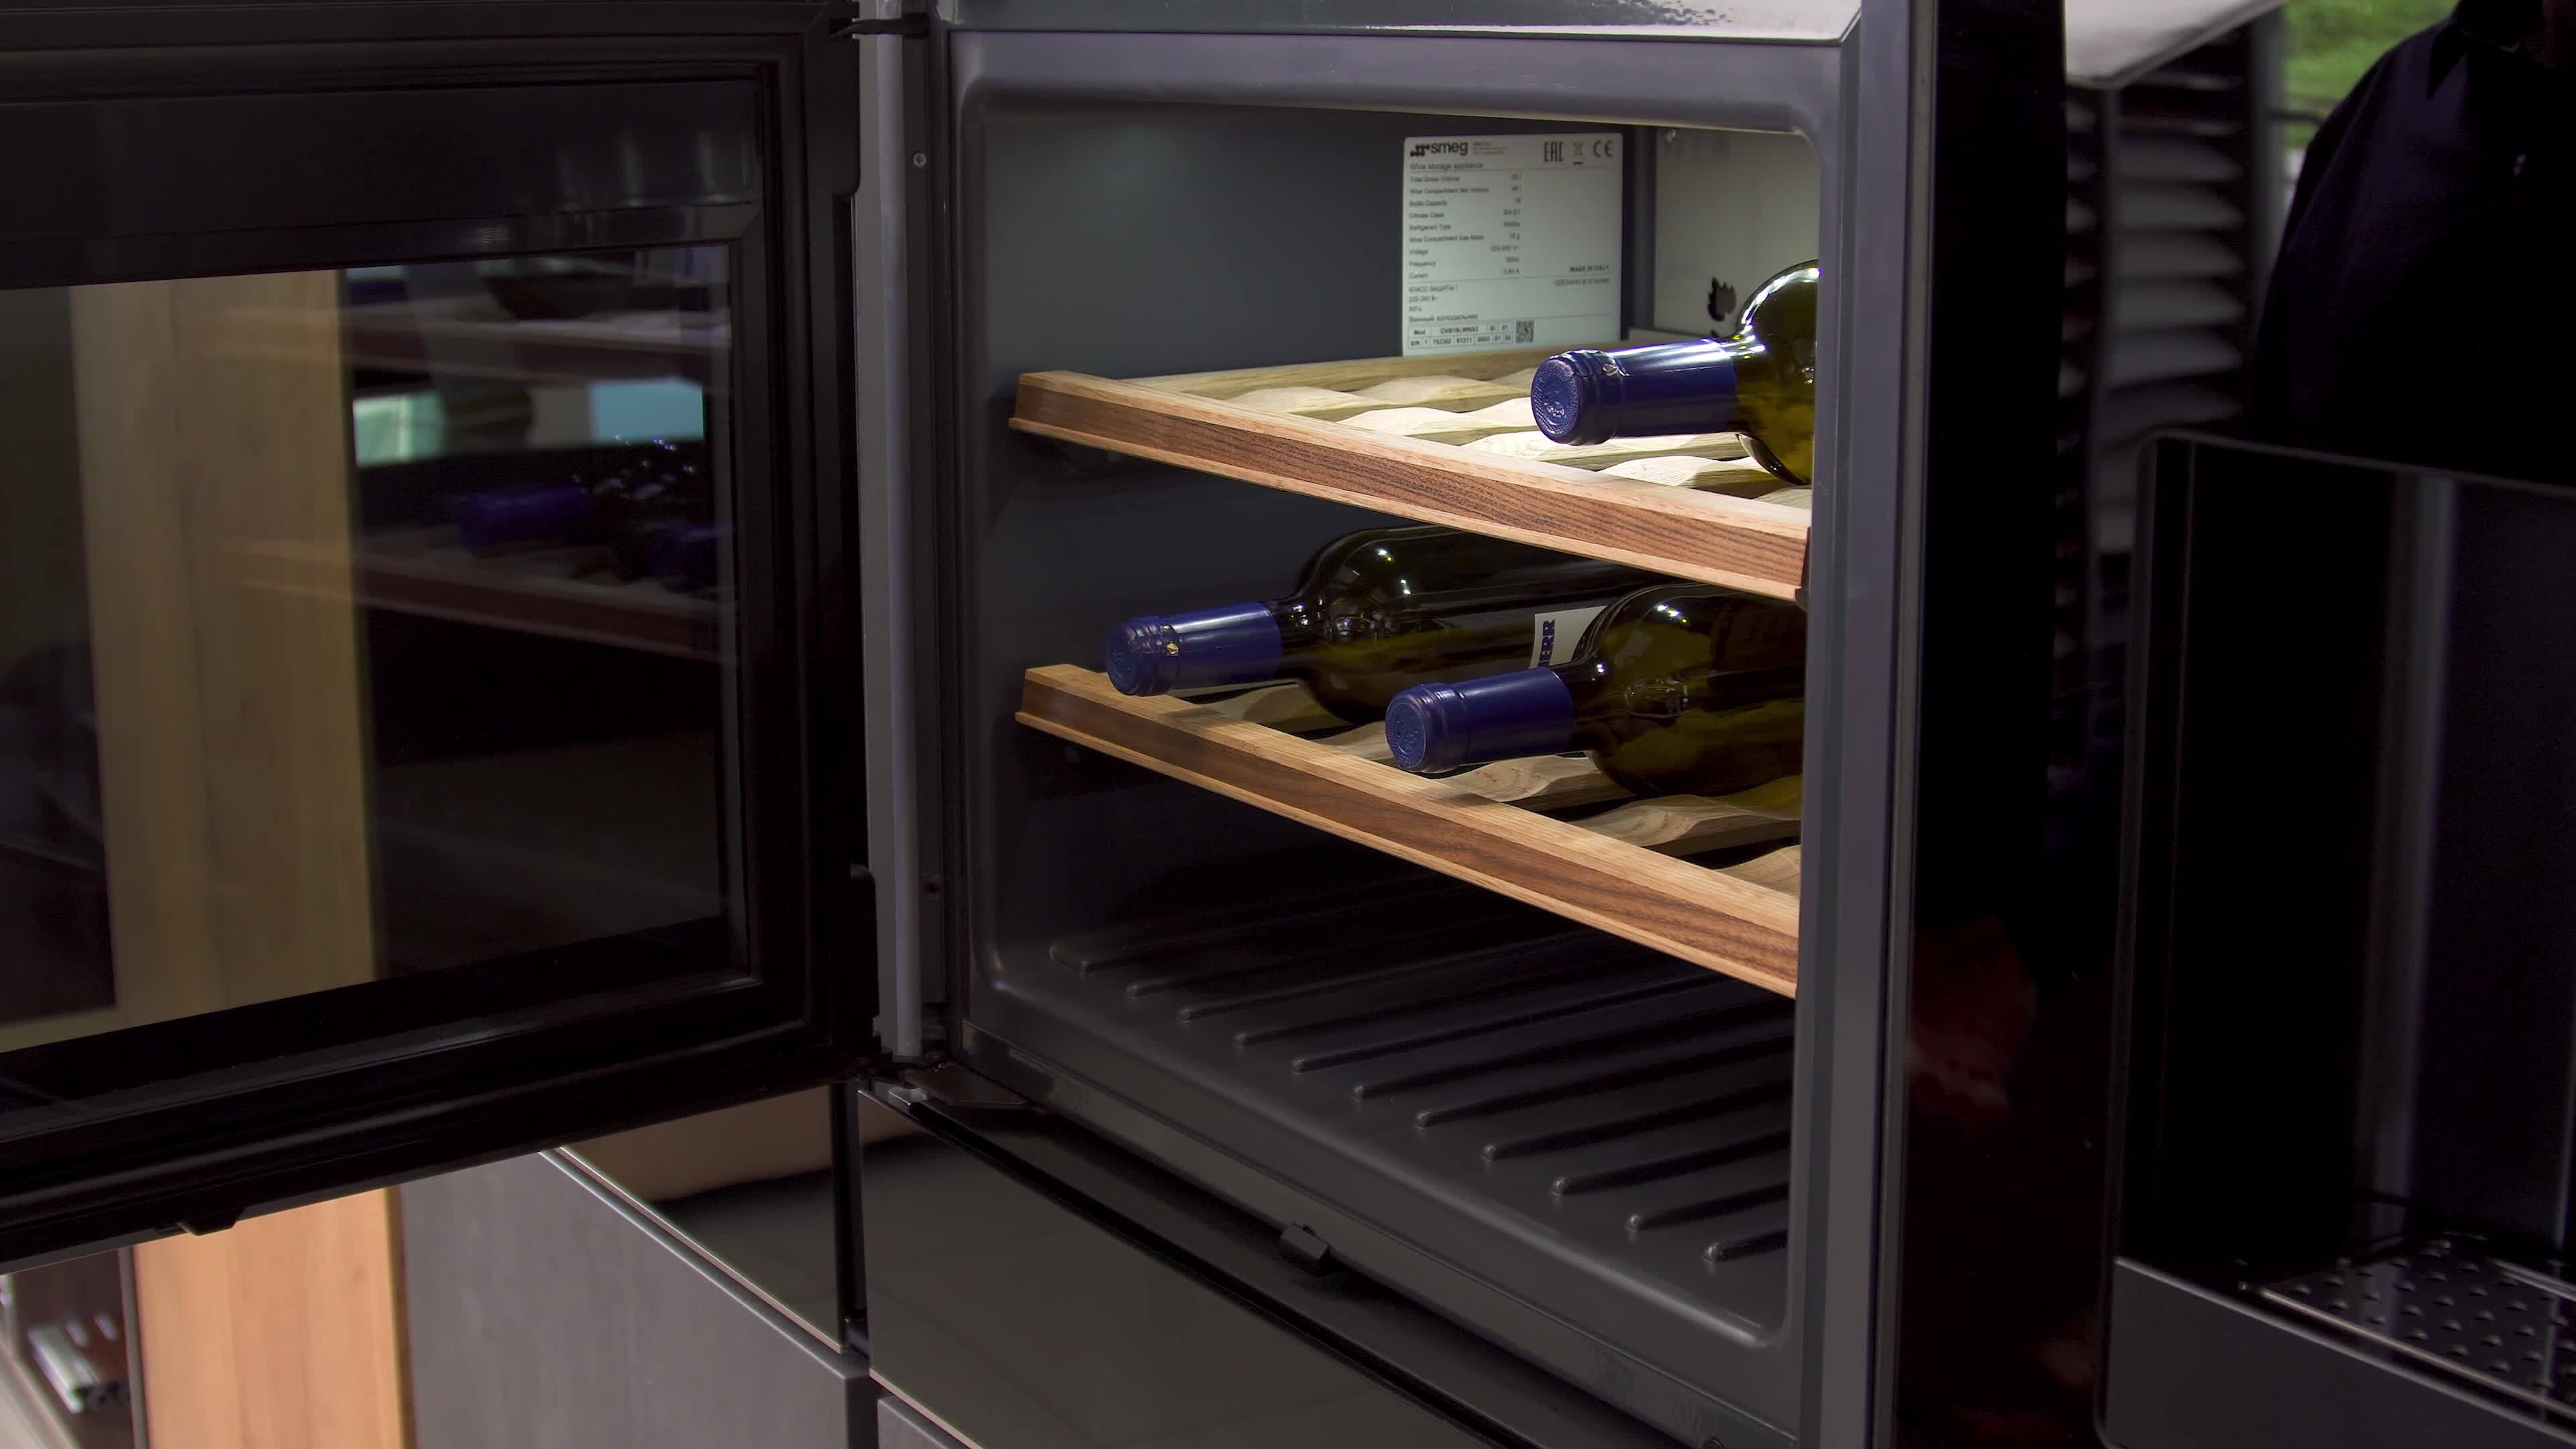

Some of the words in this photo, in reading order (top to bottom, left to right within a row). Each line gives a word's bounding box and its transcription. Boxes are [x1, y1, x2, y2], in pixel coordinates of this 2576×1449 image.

[1431, 142, 1468, 156] smeg
[1593, 140, 1613, 157] CE
[1428, 162, 1452, 171] storage
[1454, 161, 1483, 170] appliance
[1424, 235, 1458, 243] Compartment
[1595, 264, 1609, 272] ITALY
